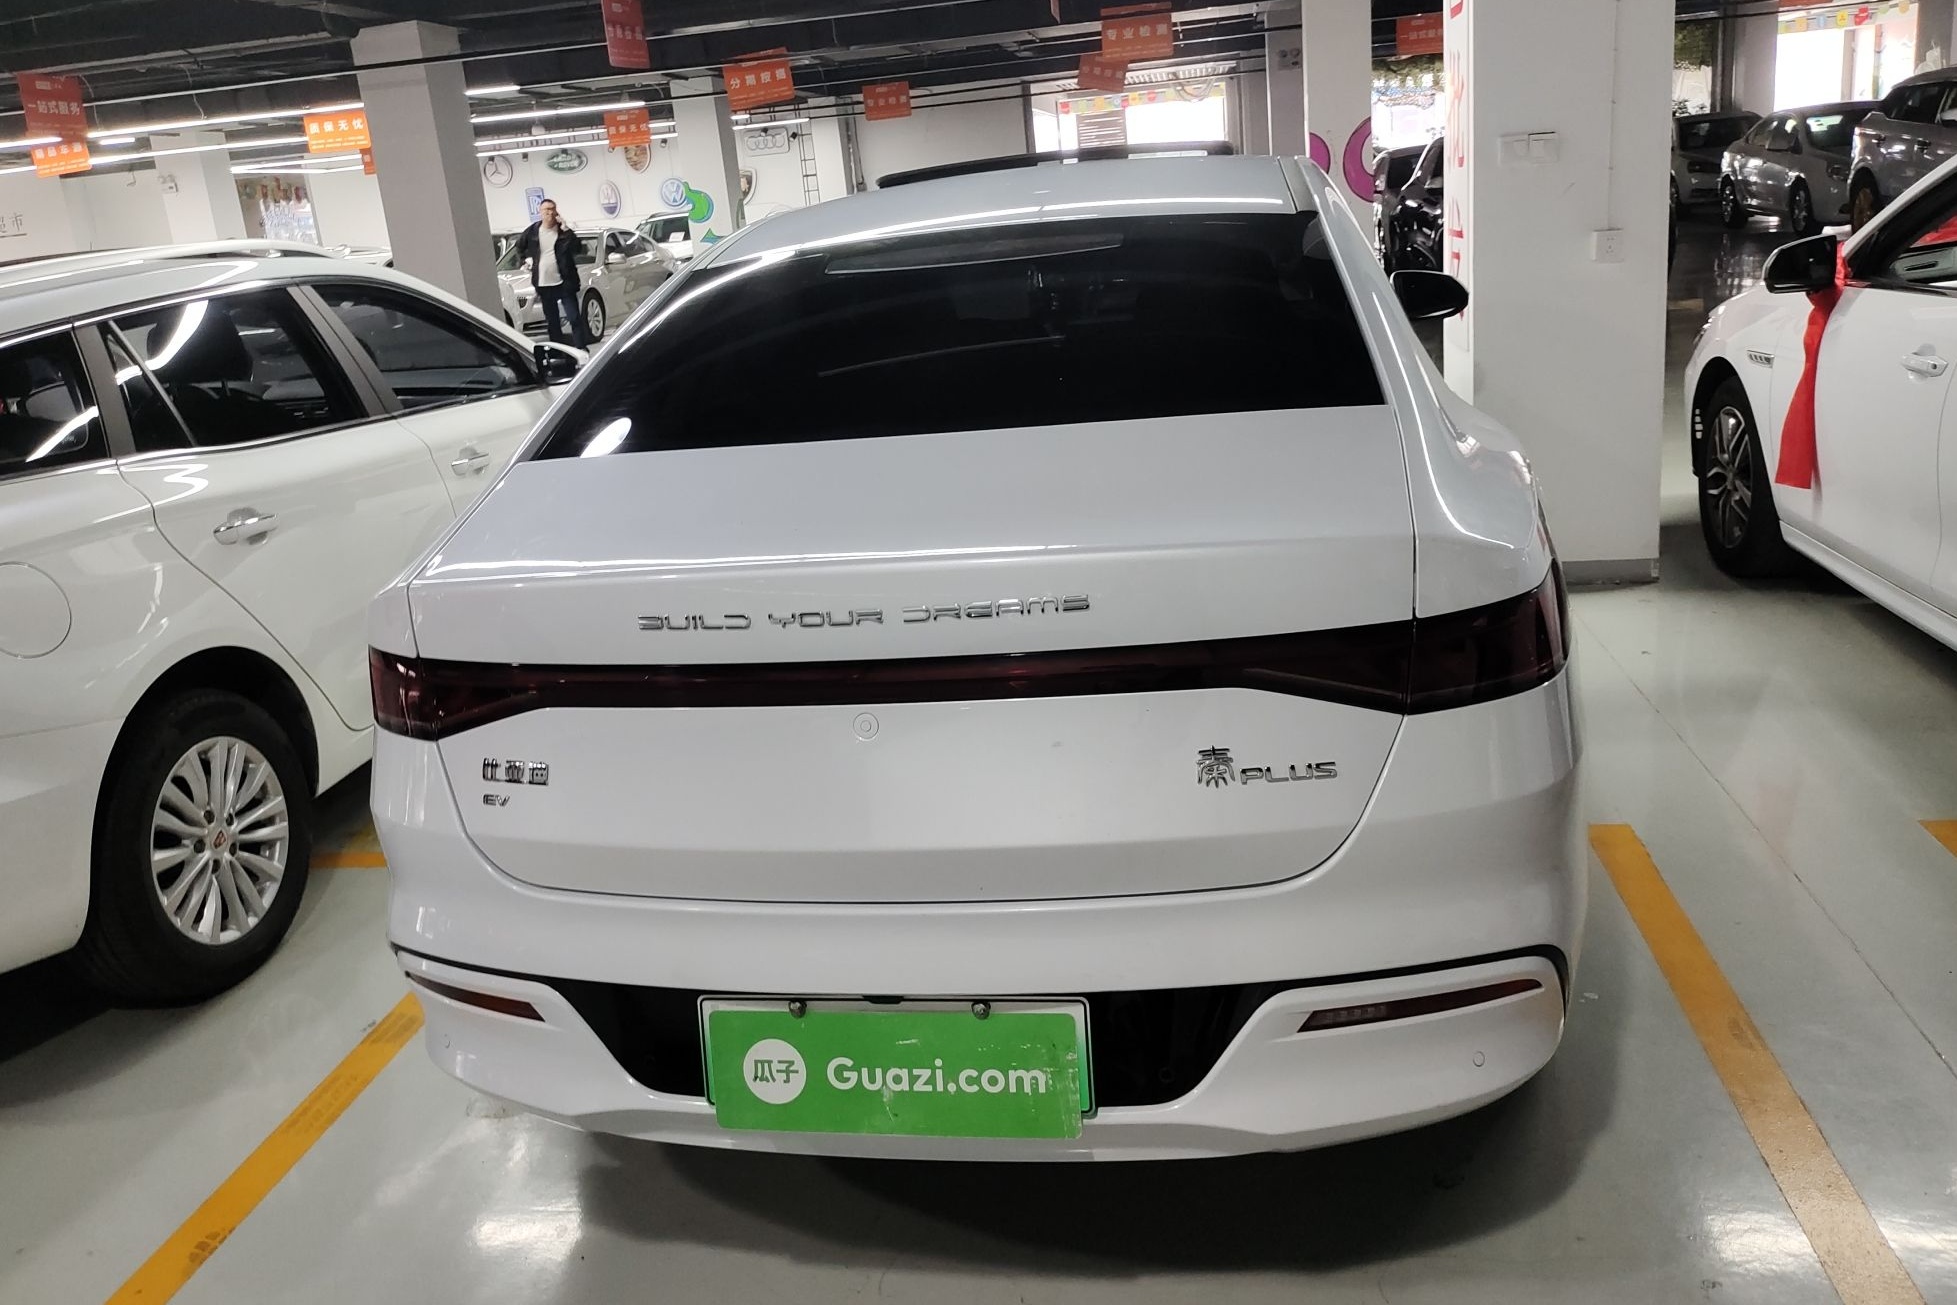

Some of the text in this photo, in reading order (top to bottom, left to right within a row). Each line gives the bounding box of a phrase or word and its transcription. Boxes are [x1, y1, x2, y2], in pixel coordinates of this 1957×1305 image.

[730, 68, 786, 89] 分期按揭
[28, 101, 80, 115] 一站式服务
[309, 118, 364, 135] 质保无忧
[638, 593, 1091, 631] BUILD YOUR DREAMS
[482, 757, 549, 786] 比亚迪
[482, 793, 511, 807] EV
[752, 1058, 800, 1085] 瓜子
[826, 1057, 1048, 1095] Guazi.com
